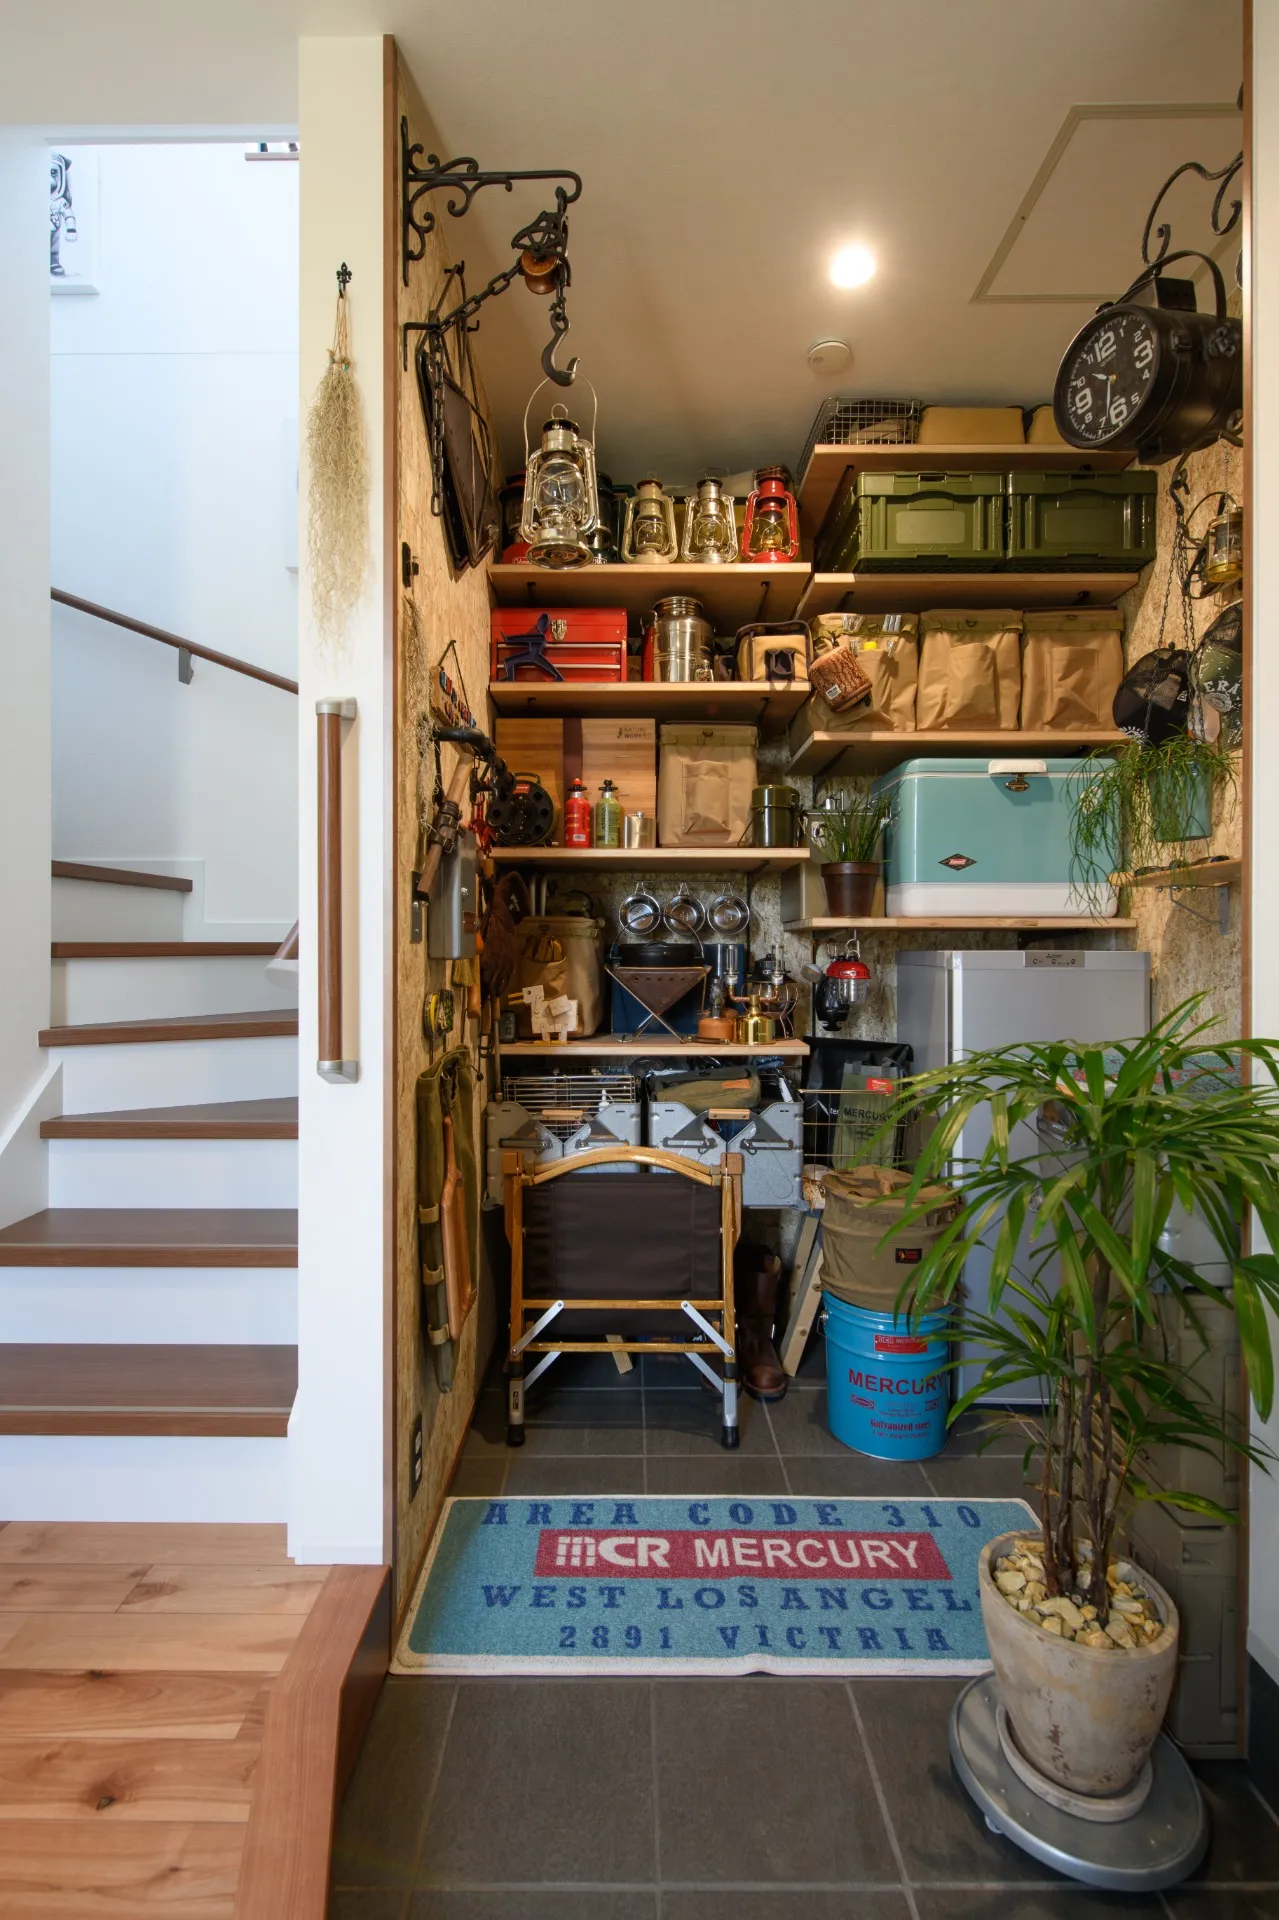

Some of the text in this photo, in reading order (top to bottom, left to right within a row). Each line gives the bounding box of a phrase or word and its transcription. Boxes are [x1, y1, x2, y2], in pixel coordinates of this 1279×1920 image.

[1119, 328, 1125, 338] 1
[1133, 330, 1143, 343] 2
[1086, 353, 1094, 365] 11
[1094, 331, 1117, 362] 12
[1133, 339, 1153, 369] 3
[1075, 375, 1086, 389] 10
[1142, 369, 1150, 380] 4
[1075, 387, 1092, 415] 9
[1109, 397, 1128, 425] 6
[1131, 392, 1140, 405] 5
[1085, 411, 1093, 424] 8
[1099, 416, 1106, 428] 7
[848, 1367, 944, 1395] MERCURY
[481, 1503, 981, 1528] AREA CODE 310
[694, 1537, 918, 1569] MERCURY
[481, 1585, 981, 1612] WEST LOS ANGEL
[559, 1624, 953, 1651] 2891 VICTRIA
